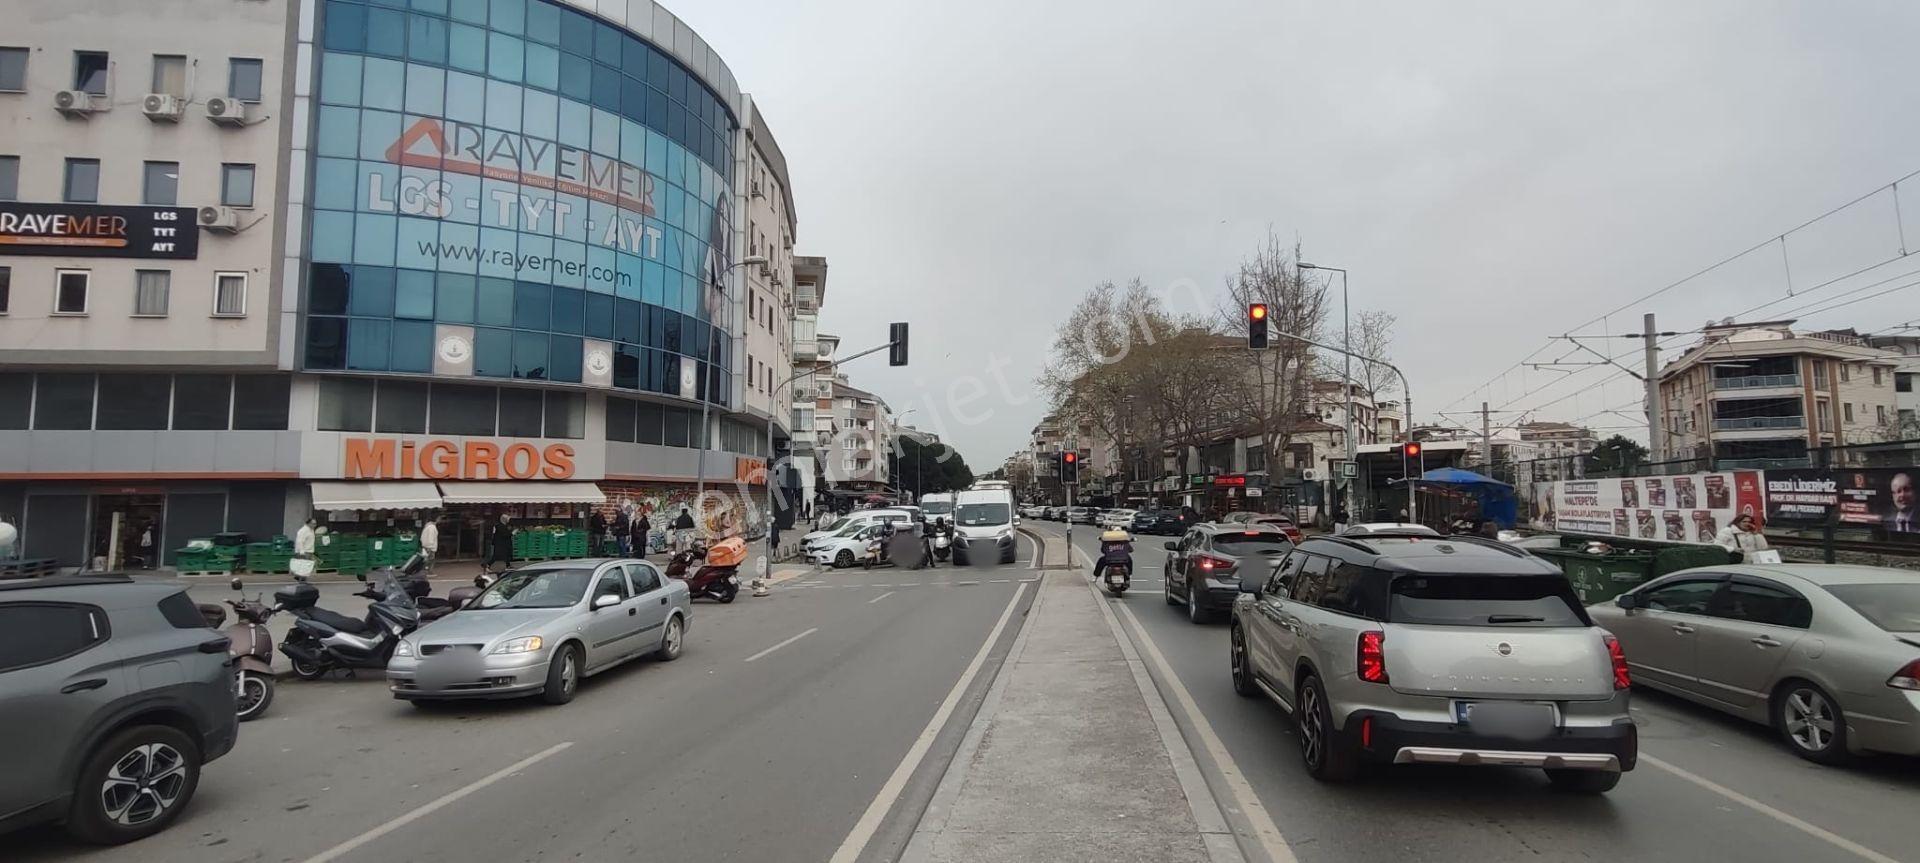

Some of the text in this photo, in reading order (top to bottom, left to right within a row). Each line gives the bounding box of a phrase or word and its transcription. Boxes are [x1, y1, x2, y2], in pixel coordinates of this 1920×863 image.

[154, 212, 178, 221] LGS
[370, 172, 453, 218] LGS
[491, 189, 571, 237] TYT
[602, 214, 663, 259] AYT
[0, 212, 127, 236] RAYEMER
[153, 227, 176, 237] TYT
[152, 242, 175, 252] AYT
[417, 239, 632, 288] www.rayemer.com
[1768, 478, 1793, 491] EBEDİ
[1794, 478, 1837, 492] LİDERİMİZ
